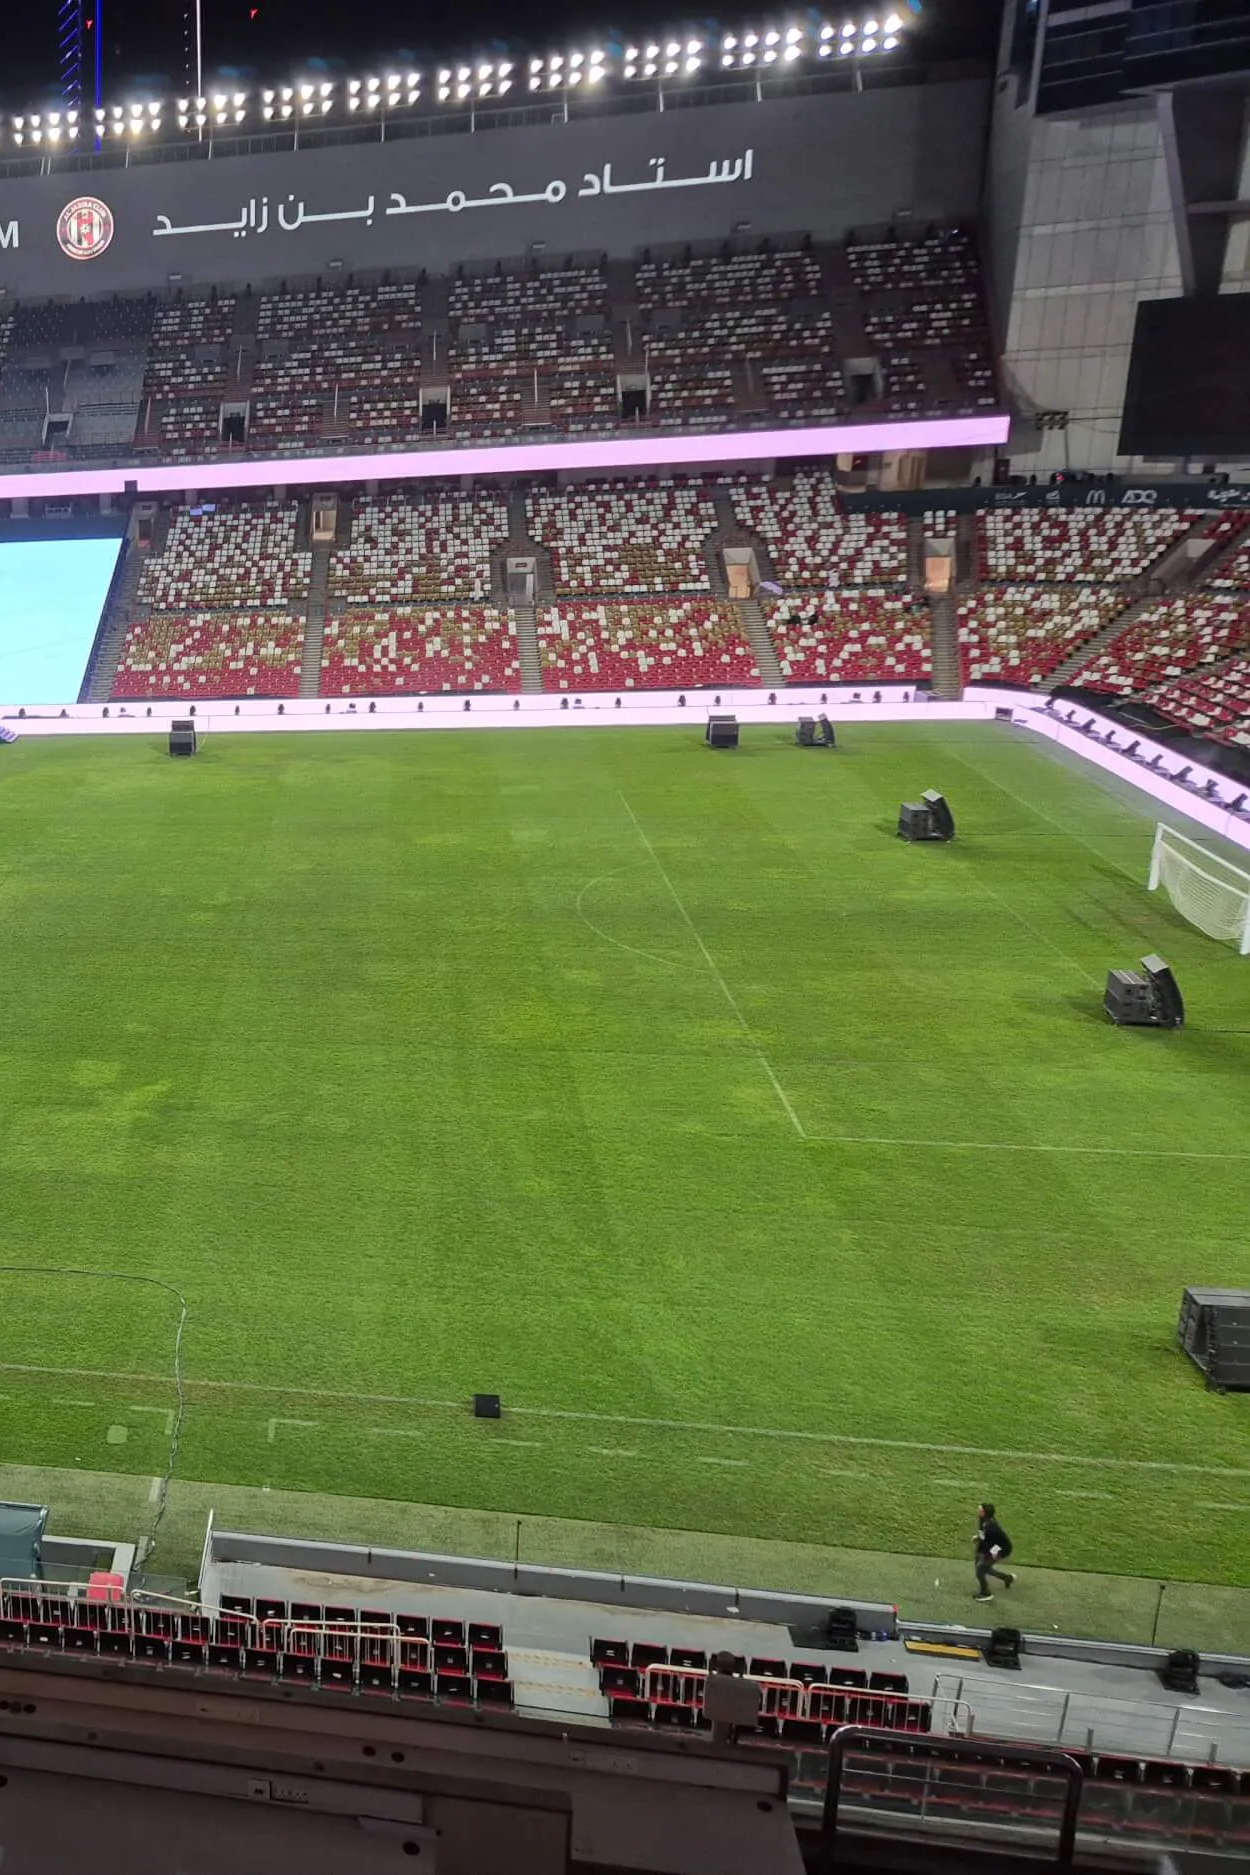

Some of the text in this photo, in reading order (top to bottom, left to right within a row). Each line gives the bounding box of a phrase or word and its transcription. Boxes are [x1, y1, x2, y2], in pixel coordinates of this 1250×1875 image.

[152, 149, 754, 238] استاد محمد بن زايد
